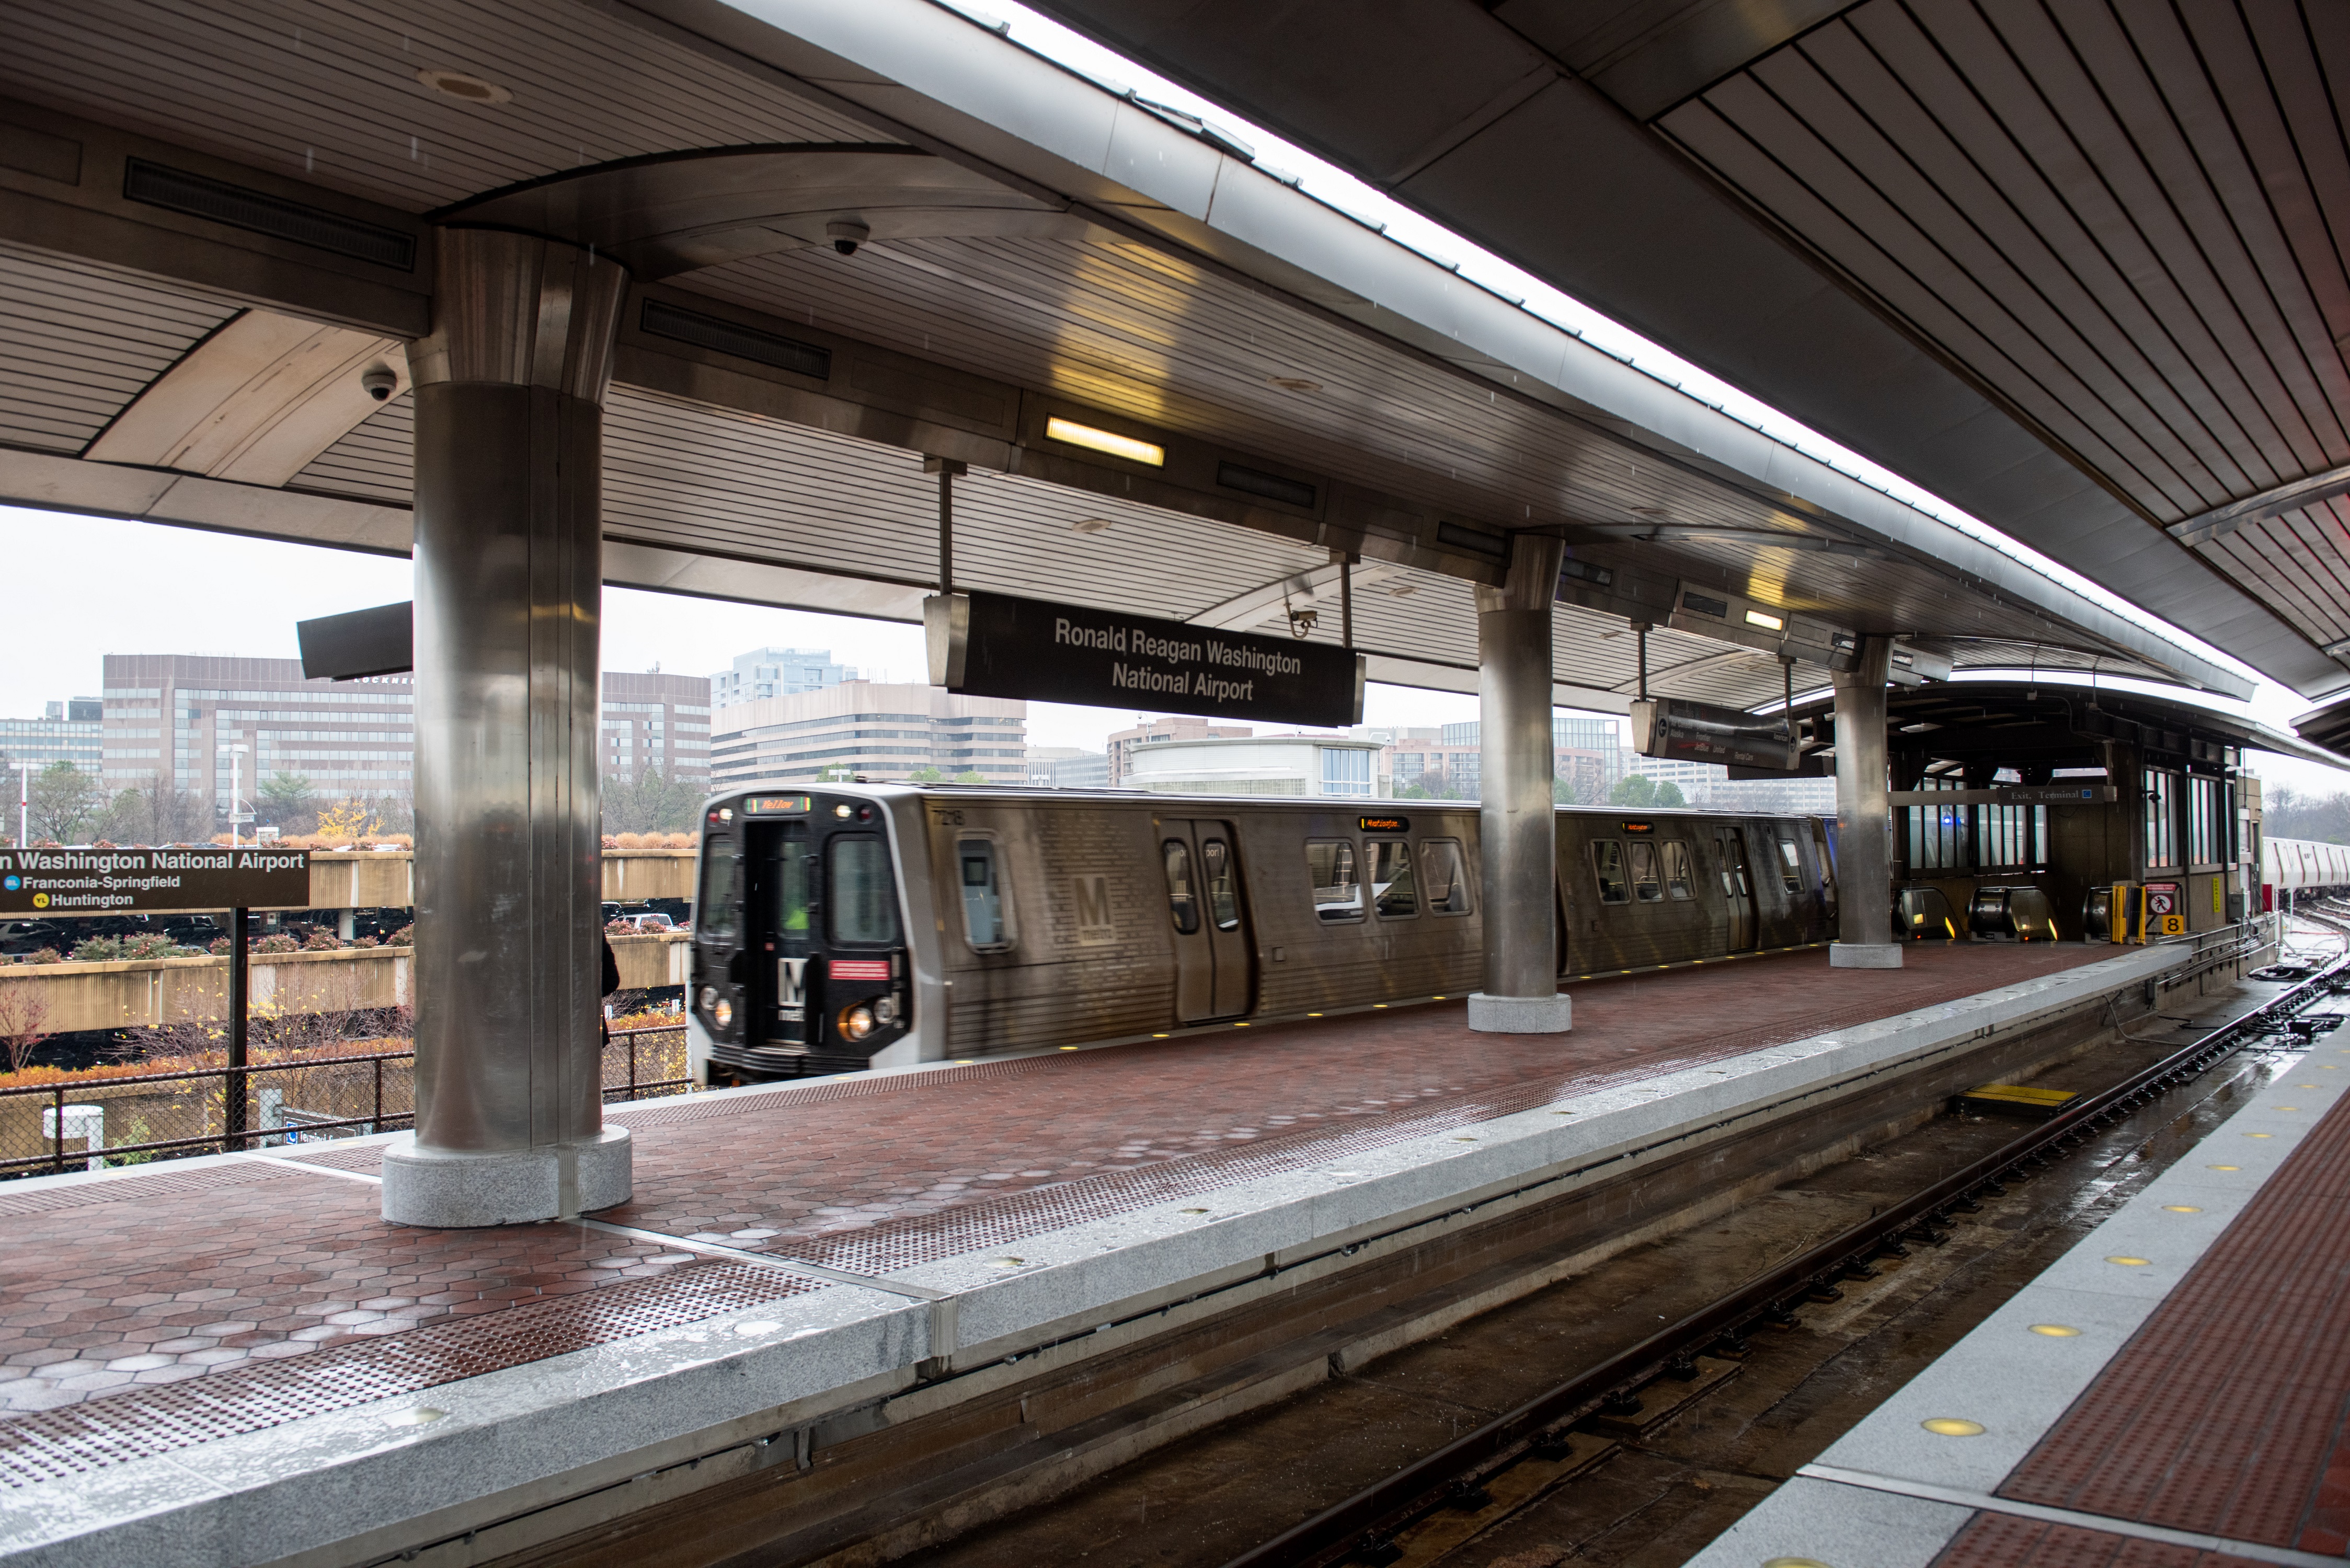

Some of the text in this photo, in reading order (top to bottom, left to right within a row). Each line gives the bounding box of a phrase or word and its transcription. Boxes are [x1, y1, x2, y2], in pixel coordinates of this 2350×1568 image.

[1056, 618, 1301, 676] Ronald Reagan Washington
[1113, 662, 1253, 702] National Airport
[1713, 745, 1725, 754] United
[2038, 790, 2079, 799] Terminal
[17, 852, 145, 873] Washington
[152, 851, 233, 869] National
[239, 852, 304, 872] Airport
[22, 876, 181, 891] Franconia-Springfield
[52, 894, 133, 908] Huntington
[2168, 918, 2179, 932] 8
